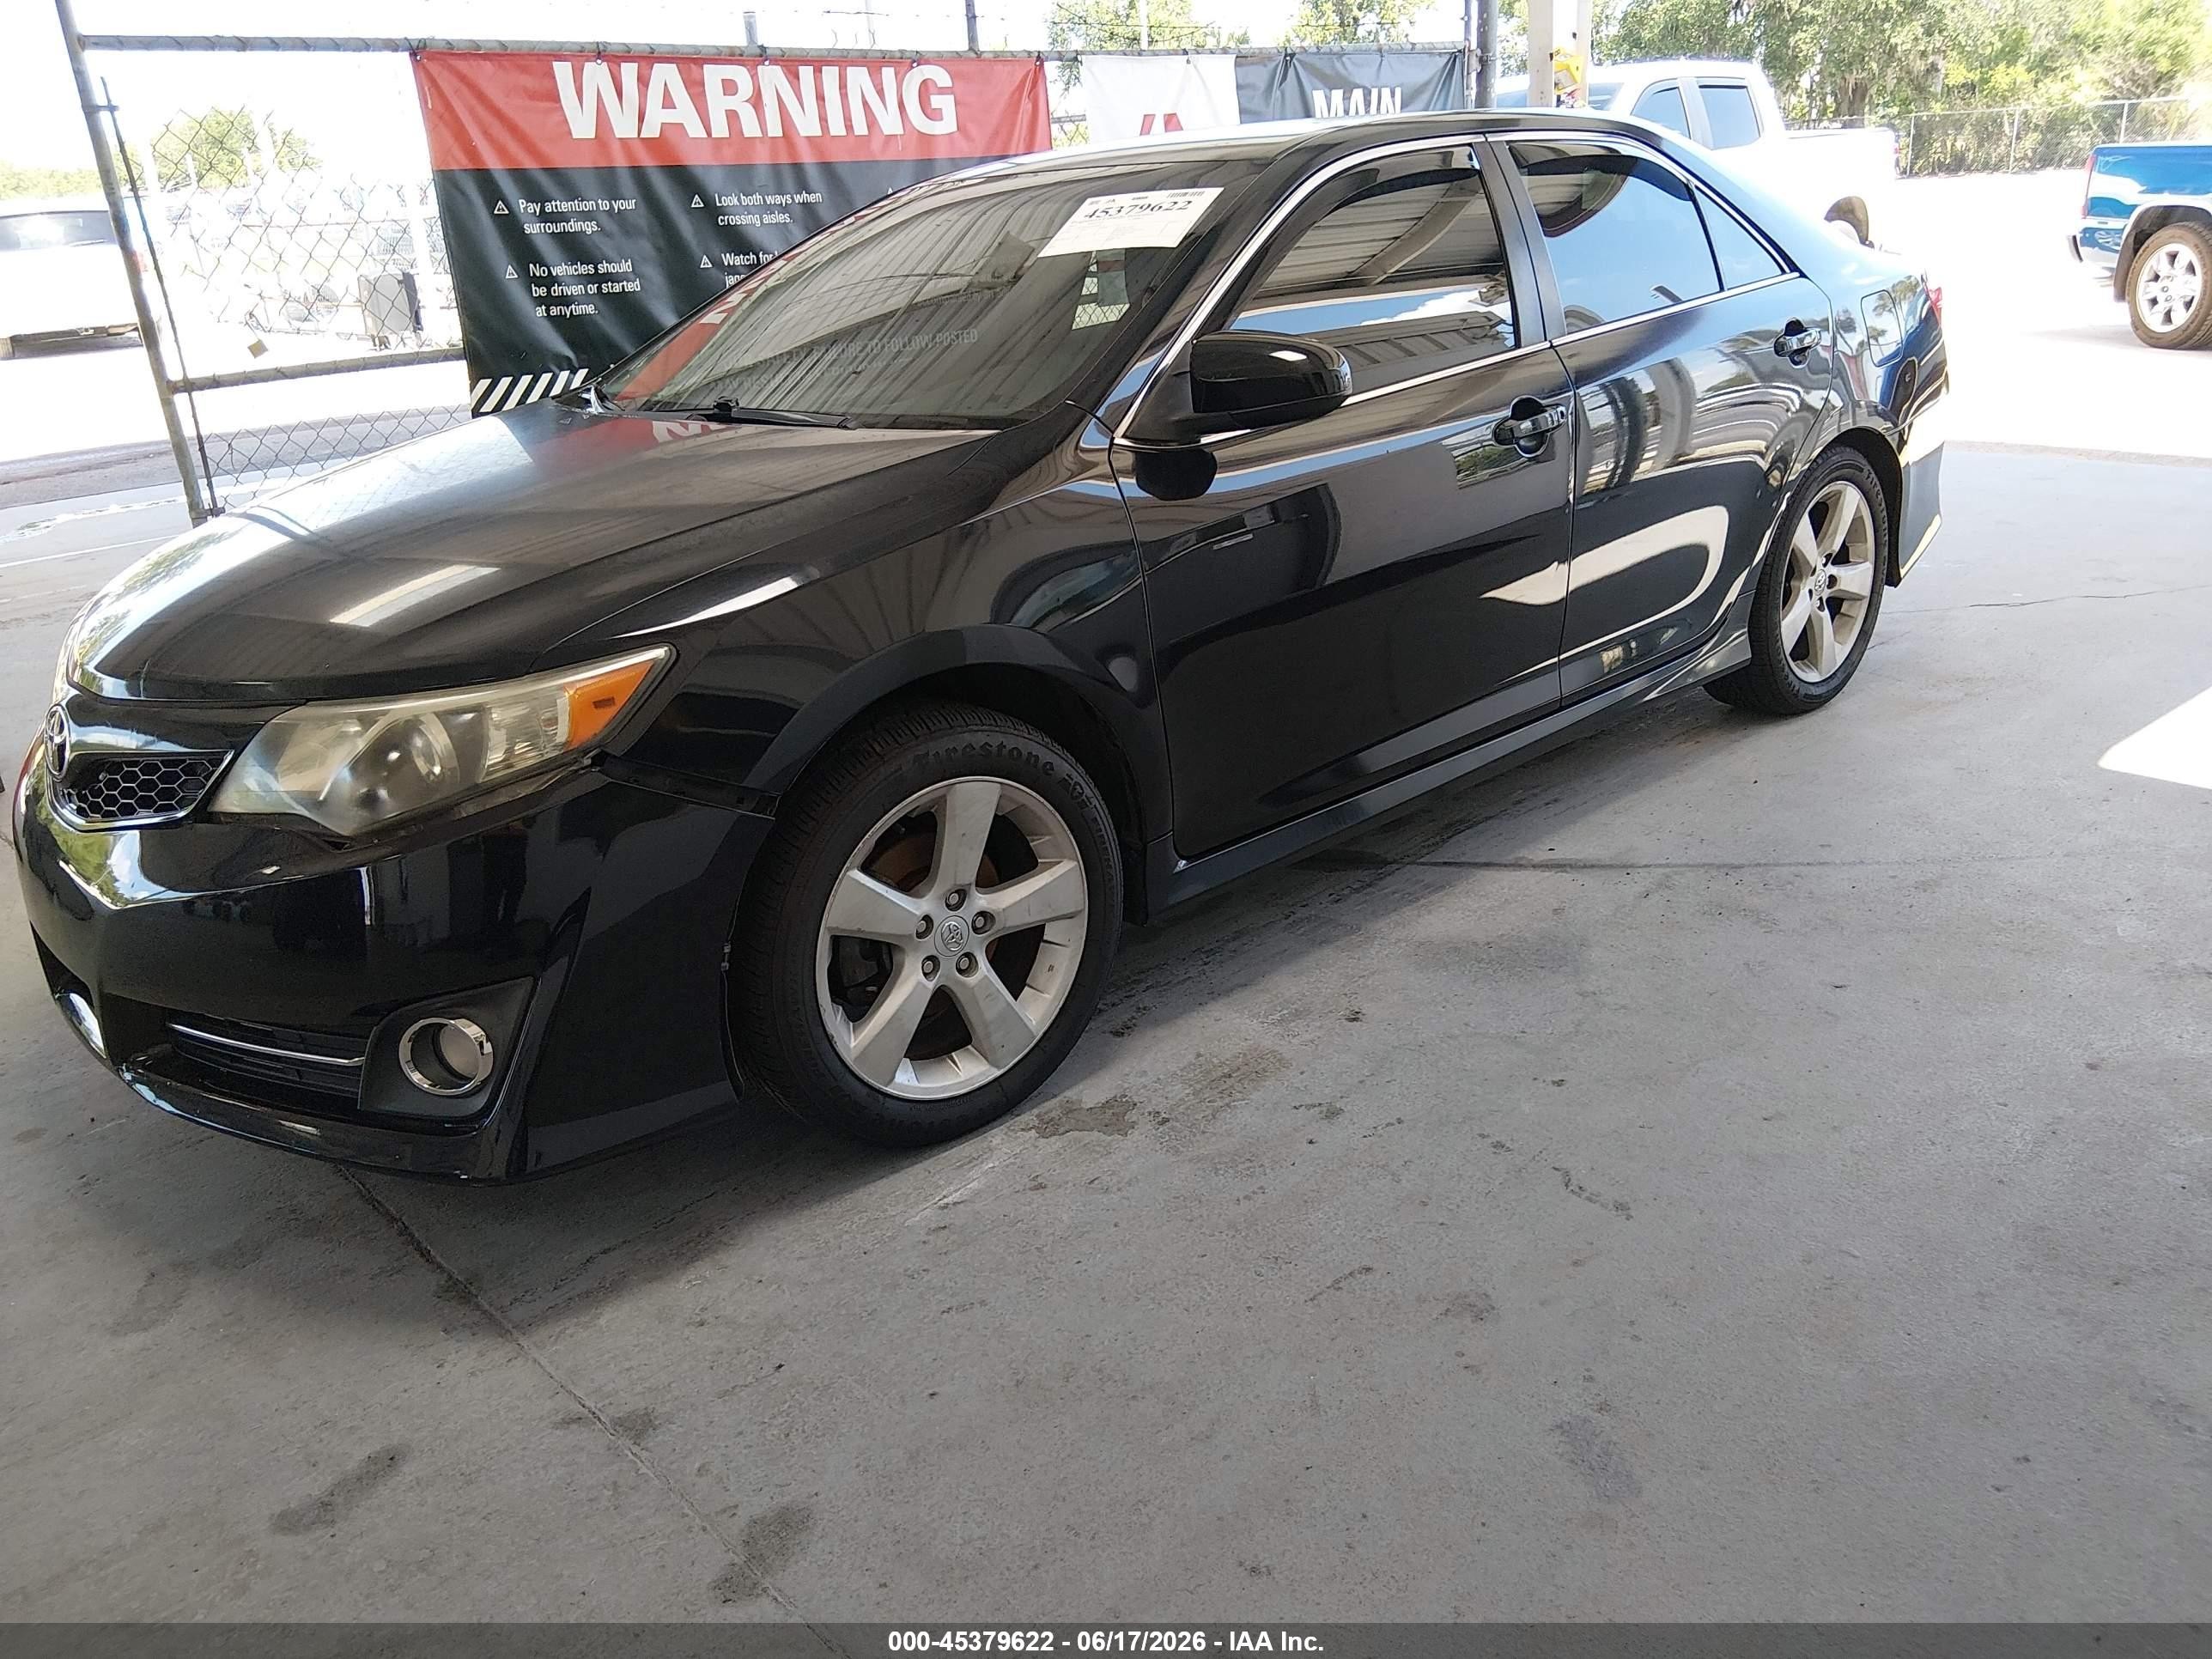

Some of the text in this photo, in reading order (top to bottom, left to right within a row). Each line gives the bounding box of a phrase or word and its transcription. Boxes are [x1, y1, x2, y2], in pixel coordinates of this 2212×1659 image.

[552, 61, 958, 139] WARNING
[519, 198, 636, 216] Pay attention to your
[715, 191, 823, 207] Look both ways when
[718, 210, 793, 227] crossing aisles.
[1084, 200, 1193, 219] 45379622
[524, 218, 601, 234] surroundings.
[529, 258, 633, 277] No vehicles should
[721, 251, 757, 266] Watch
[759, 251, 773, 264] for
[532, 278, 641, 297] be driven or started
[535, 301, 599, 319] at anytime.
